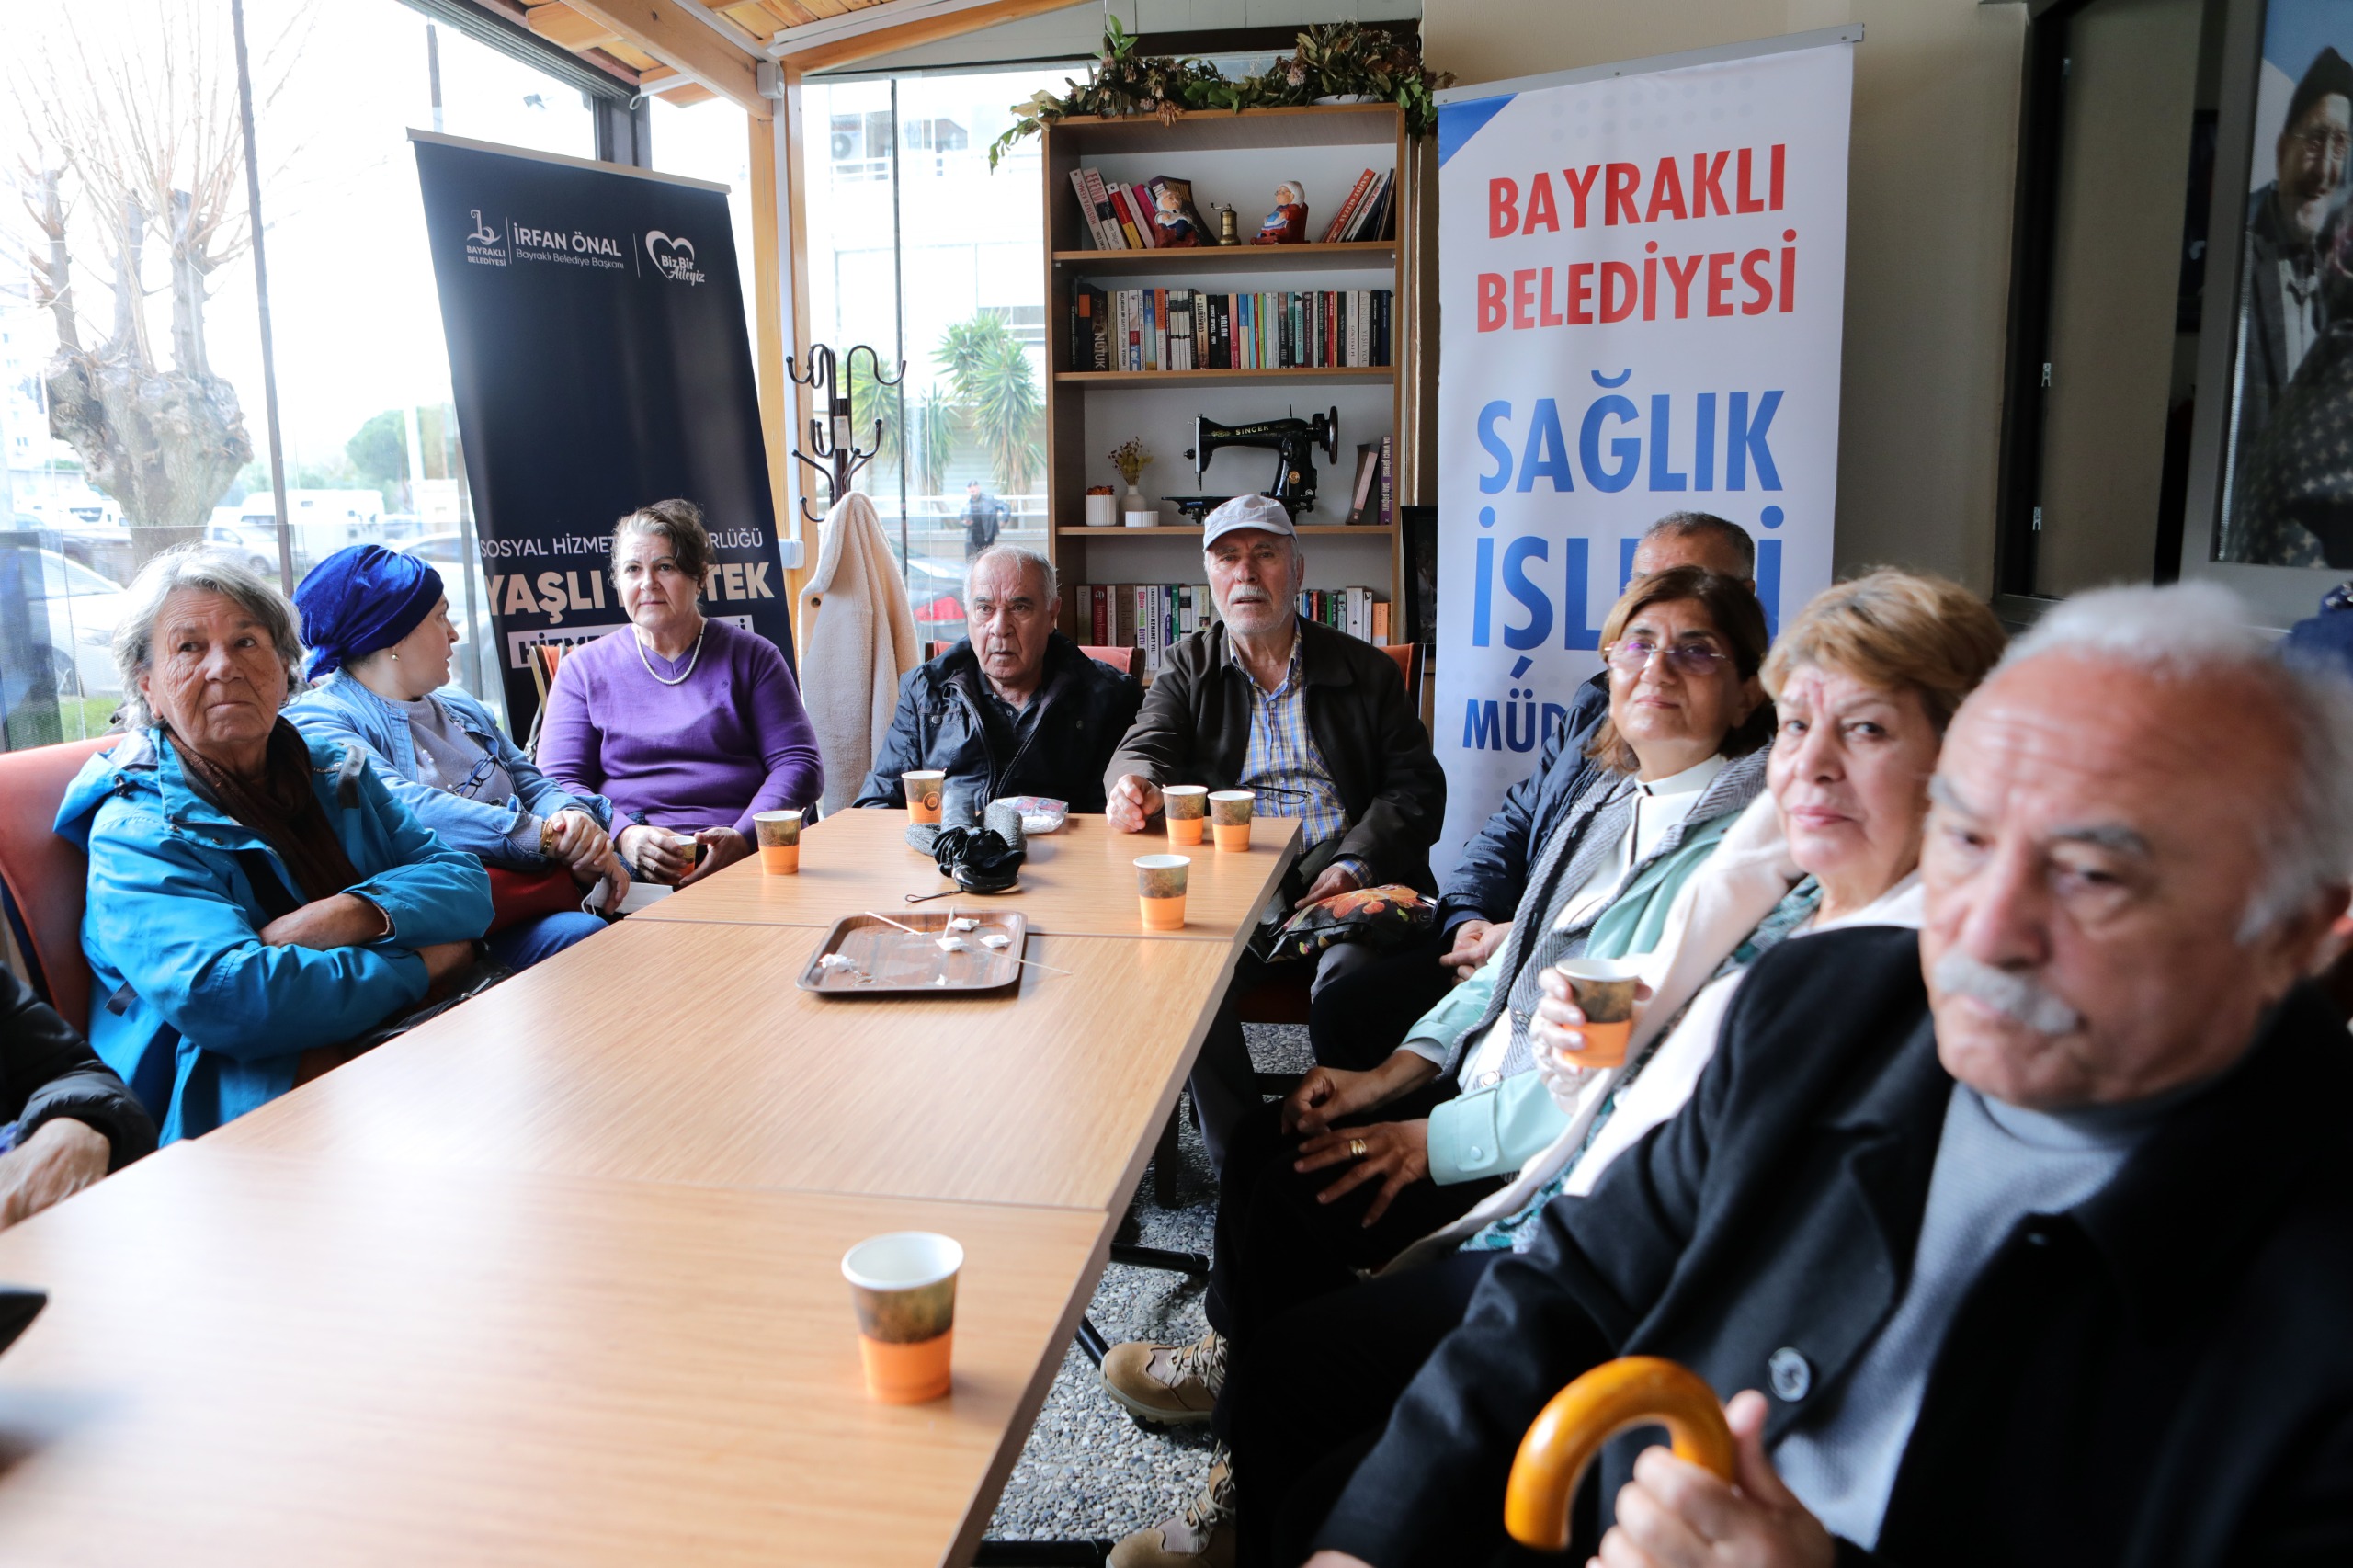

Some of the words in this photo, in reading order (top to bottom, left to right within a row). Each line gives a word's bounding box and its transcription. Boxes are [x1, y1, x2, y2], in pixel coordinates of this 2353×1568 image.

[1489, 143, 1786, 239] BAYRAKLI
[466, 245, 506, 257] BAYRAKLI
[513, 222, 568, 251] İRFAN
[571, 231, 622, 257] ÖNAL
[467, 256, 506, 267] BELEDİYESİ
[516, 248, 552, 263] Bayraklı
[553, 253, 591, 267] Belediye
[591, 256, 625, 269] Başkanı
[660, 254, 678, 268] Biz
[678, 257, 694, 271] Bir
[668, 266, 705, 287] Aileyiz
[1477, 228, 1797, 333] BELEDİYESİ
[1221, 315, 1229, 337] NUTUK
[1094, 332, 1106, 369] NUTUK
[1235, 425, 1269, 436] SINGER
[1477, 369, 1785, 495] SAĞLIK
[480, 537, 549, 559] SOSYAL
[552, 532, 617, 555] HİZMET
[708, 528, 763, 549] RLÜĞÜ
[485, 568, 605, 625] YAŞLI
[1472, 505, 1785, 681] İŞLİ
[1138, 629, 1146, 645] DİYETİ
